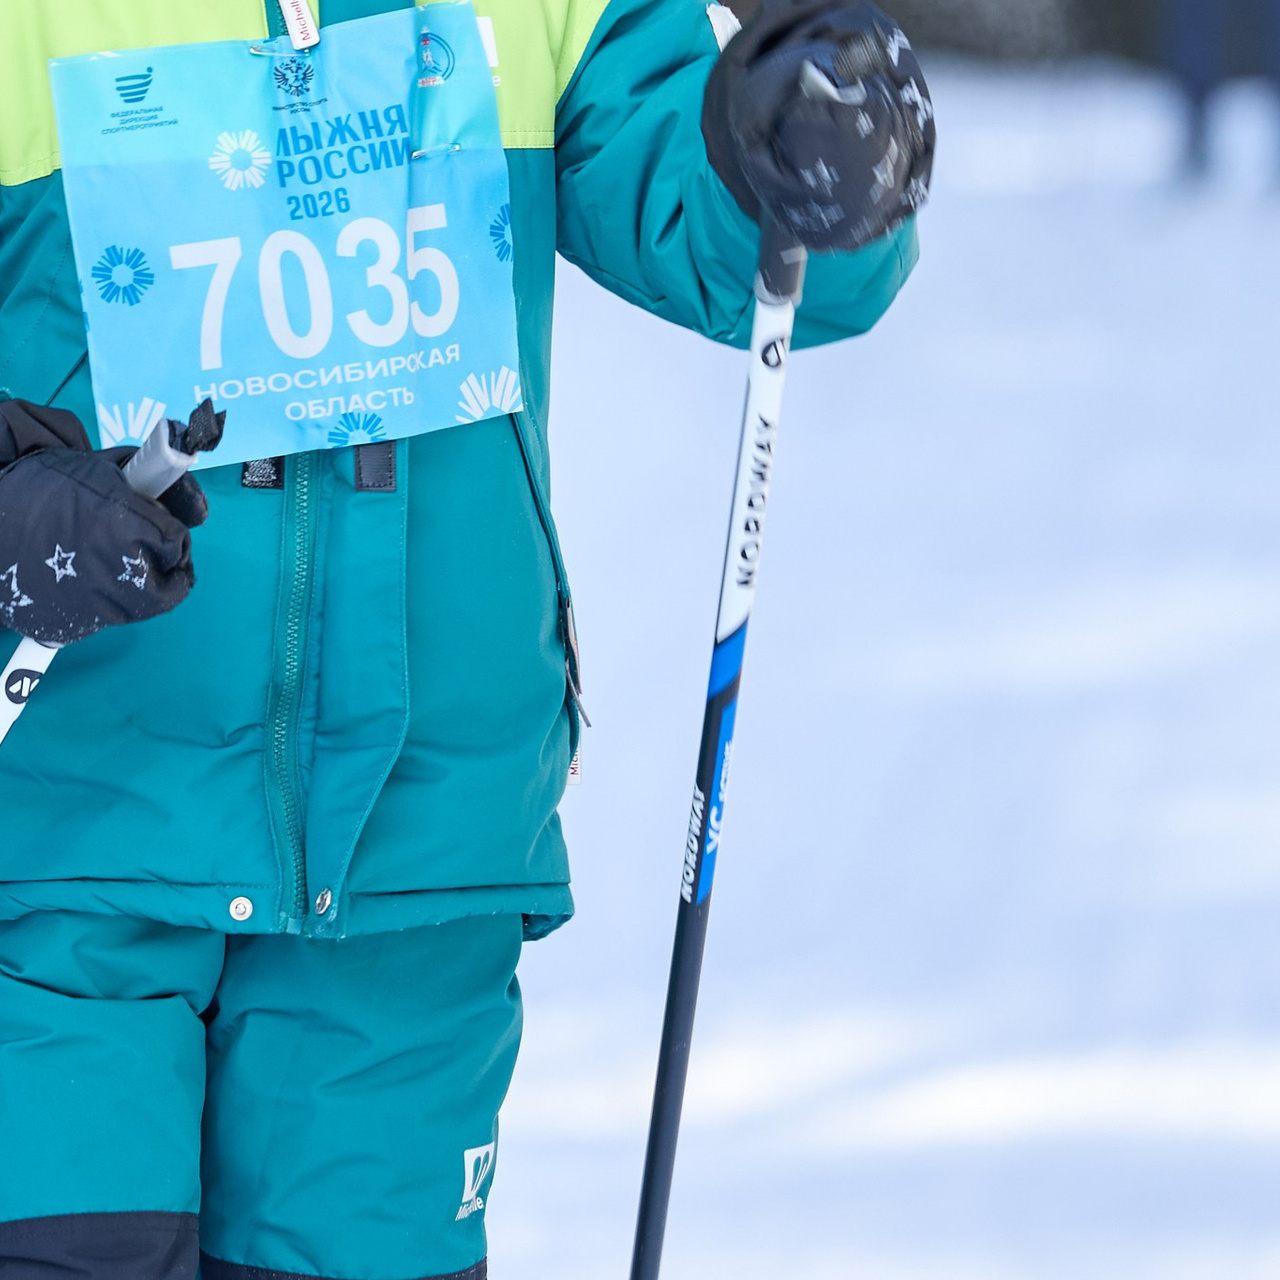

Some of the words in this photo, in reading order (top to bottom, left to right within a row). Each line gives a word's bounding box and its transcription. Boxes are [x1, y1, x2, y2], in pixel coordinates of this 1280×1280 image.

[276, 104, 408, 157] ЛЫЖНЯ
[277, 136, 411, 188] РОССИИ
[286, 187, 350, 221] 2026
[169, 203, 460, 371] 7035
[285, 387, 415, 421] ОБЛАСТЬ
